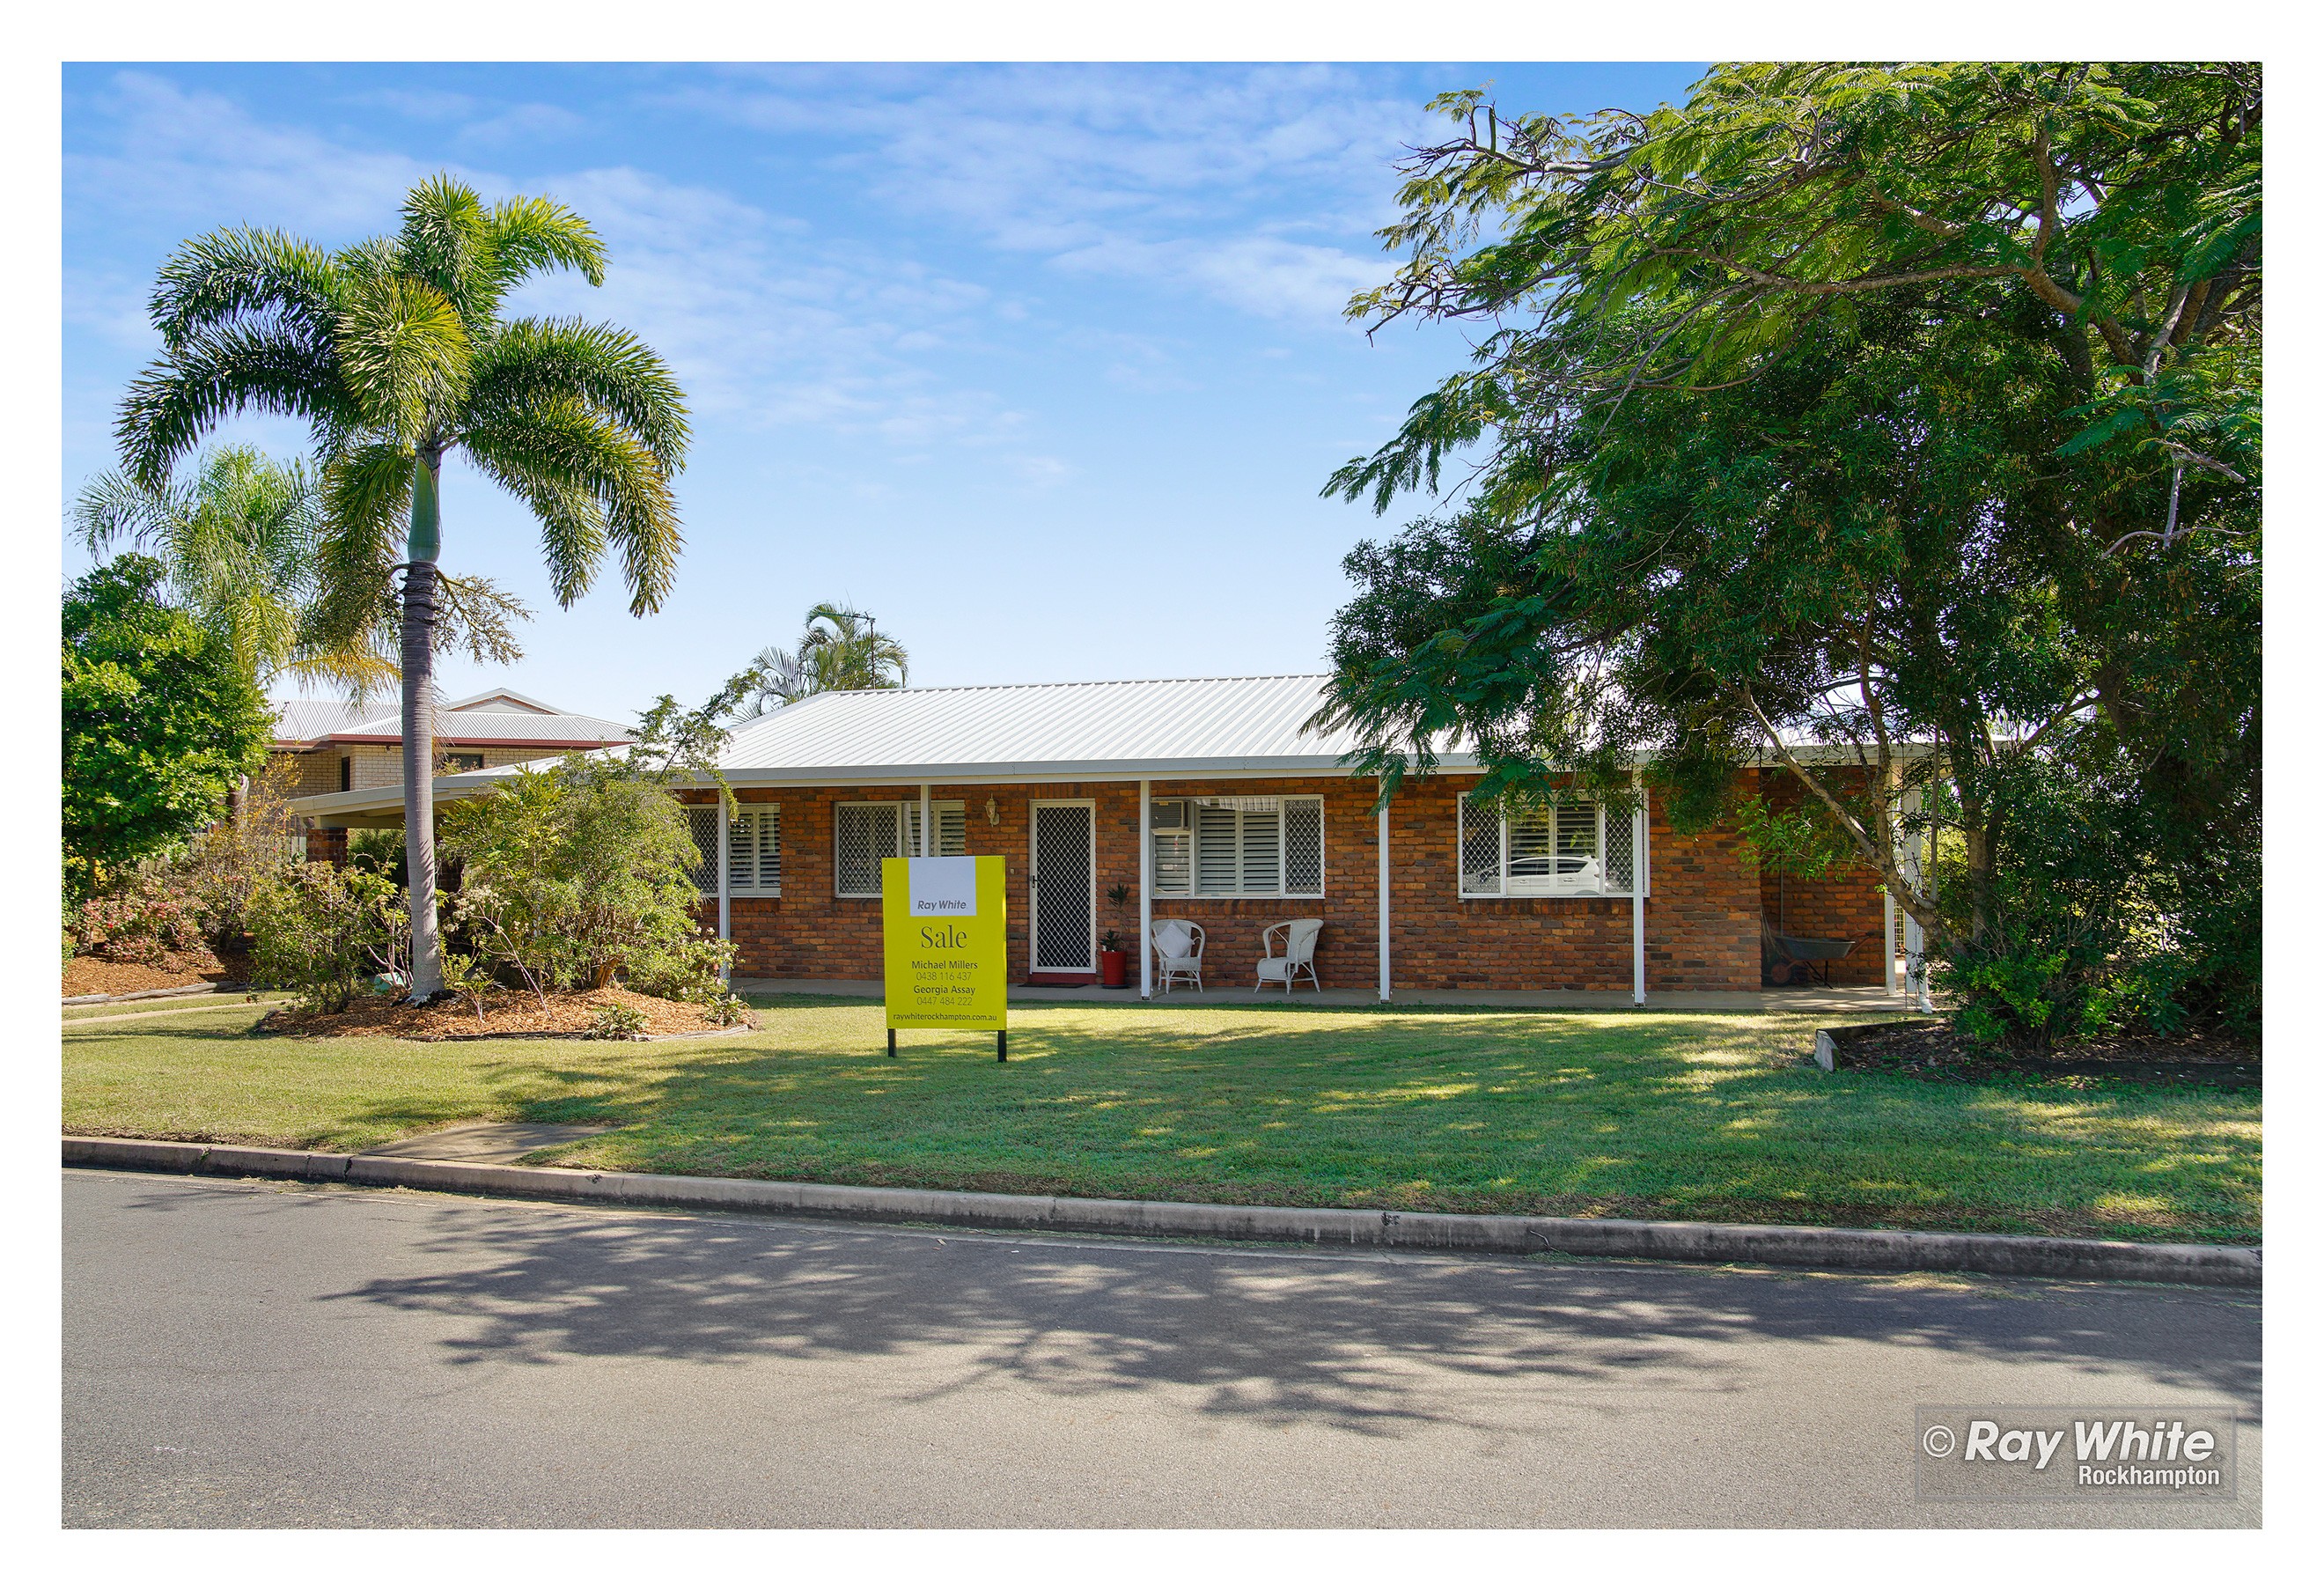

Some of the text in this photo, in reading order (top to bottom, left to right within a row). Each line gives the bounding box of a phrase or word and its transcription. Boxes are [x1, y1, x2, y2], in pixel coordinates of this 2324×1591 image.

[917, 901, 967, 911] Ray White
[921, 924, 967, 949] Sale
[957, 972, 971, 981] 437
[914, 985, 975, 996] Georgia Assay
[916, 997, 938, 1005] 0447
[894, 1013, 997, 1022] raywhiterockhampton.com.au
